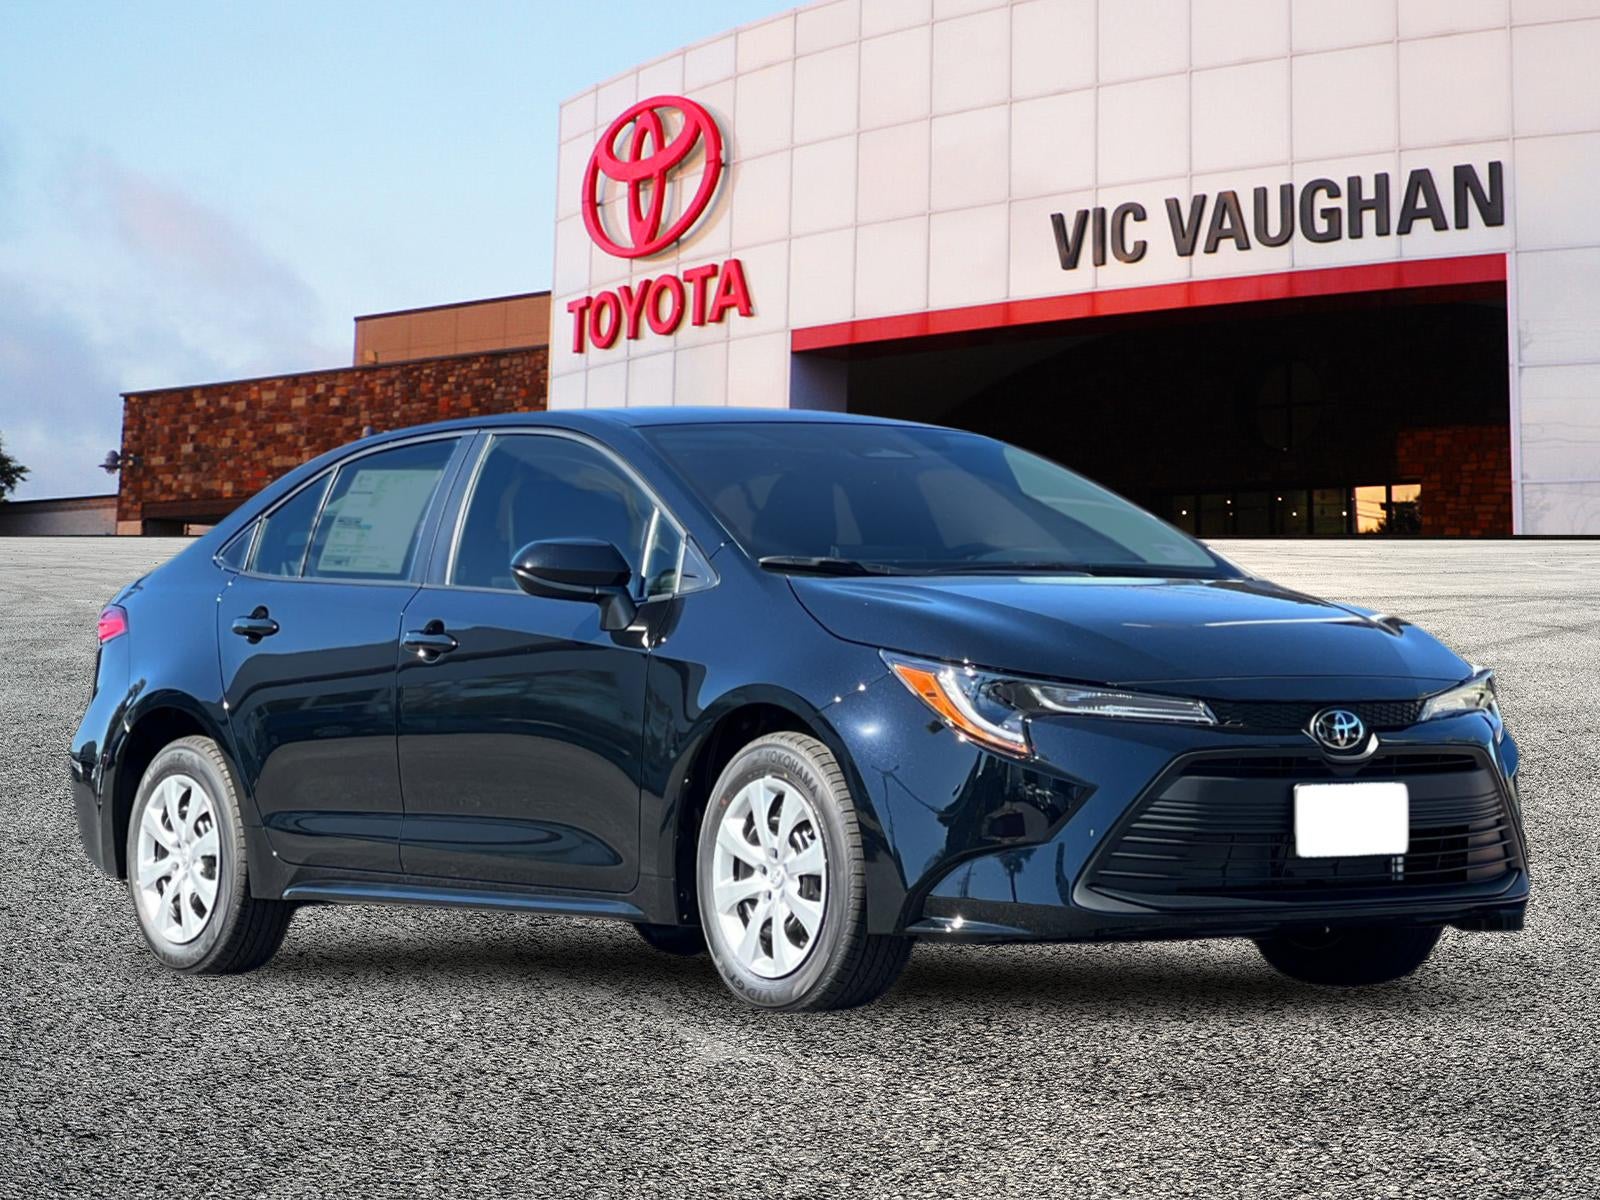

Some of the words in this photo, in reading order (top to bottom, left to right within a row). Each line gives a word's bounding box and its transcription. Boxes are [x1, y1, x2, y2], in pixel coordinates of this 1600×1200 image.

[1050, 202, 1147, 270] VIC
[1165, 160, 1505, 257] VAUGHAN
[567, 258, 754, 353] TOYOTA
[765, 750, 818, 797] YOKOHAMA
